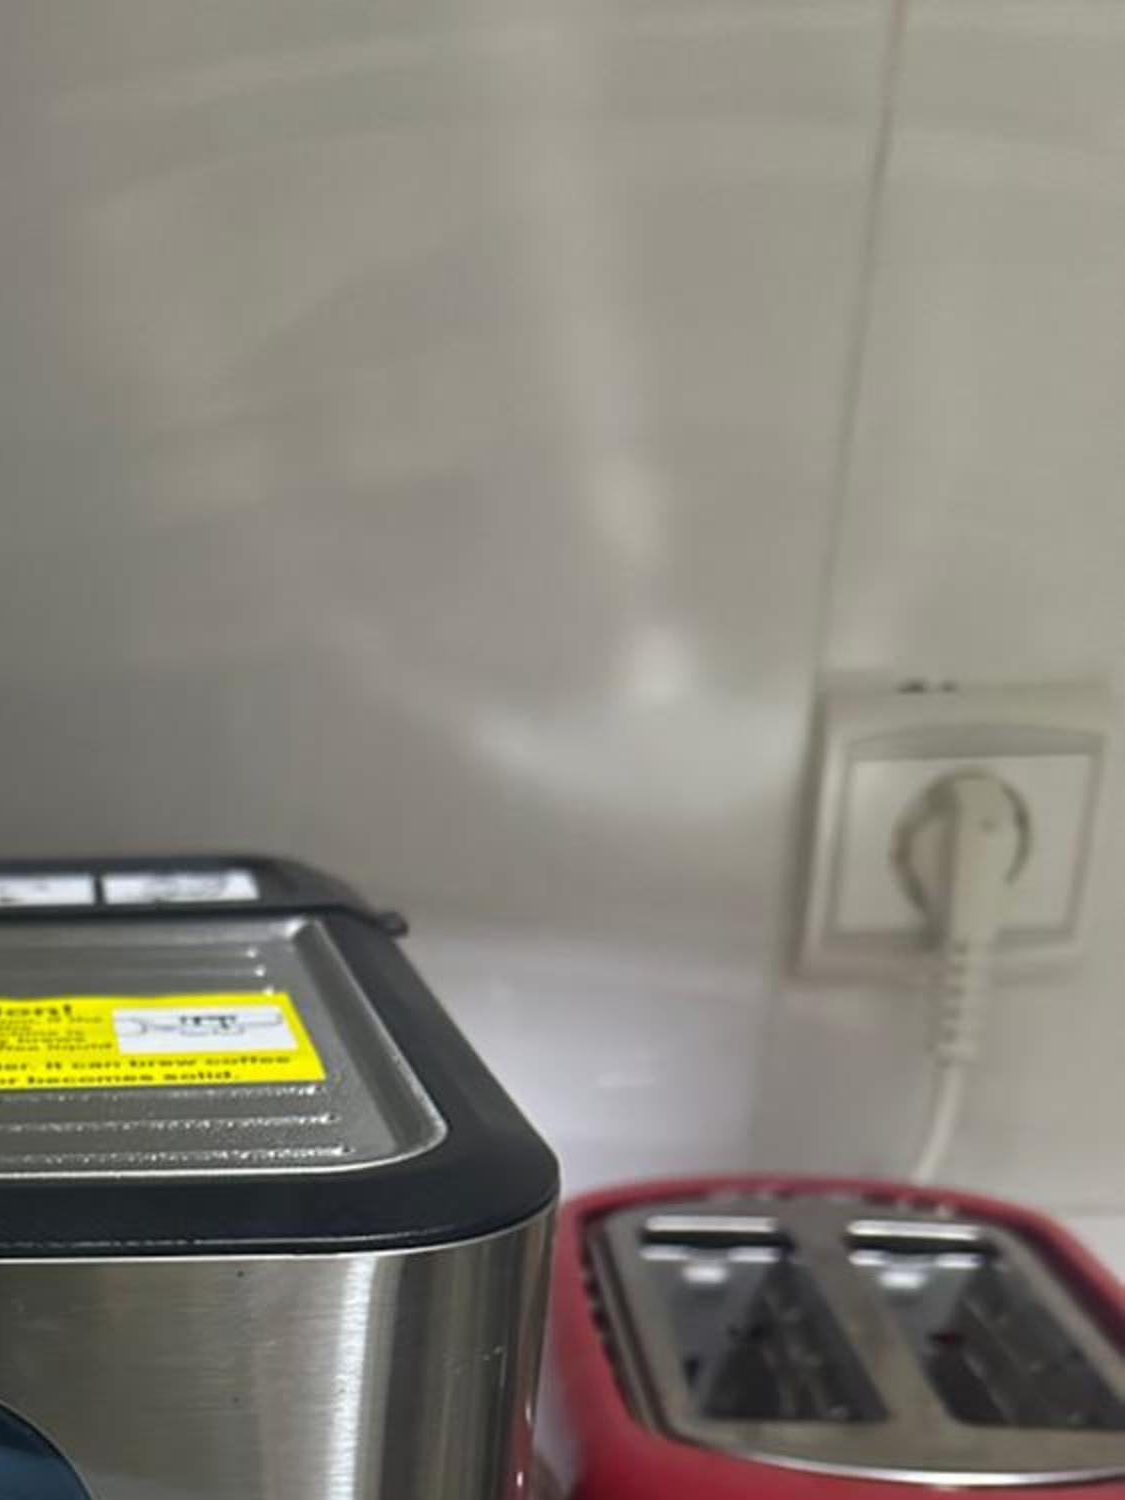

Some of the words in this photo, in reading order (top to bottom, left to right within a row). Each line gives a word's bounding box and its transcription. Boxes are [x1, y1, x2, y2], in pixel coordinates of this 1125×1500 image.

[71, 1060, 122, 1070] can
[129, 1057, 197, 1068] brew
[205, 1055, 292, 1066] coffee
[27, 1074, 154, 1085] becomes
